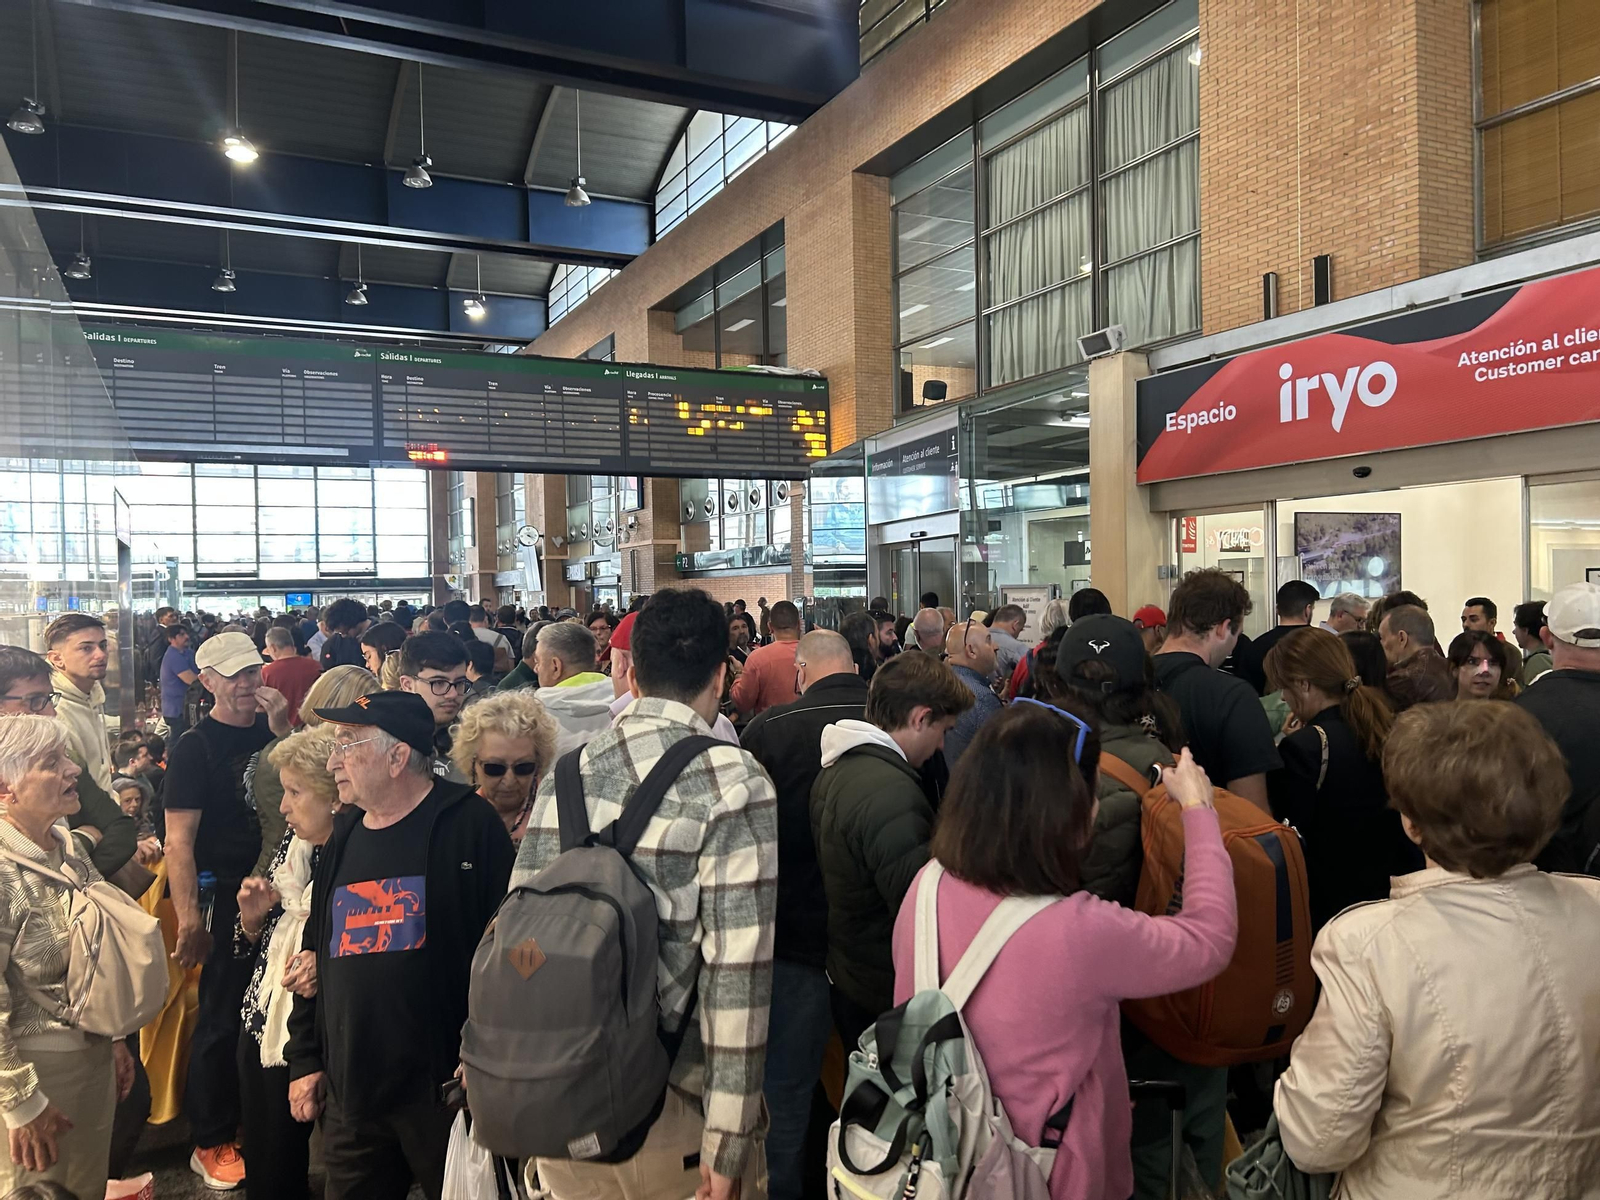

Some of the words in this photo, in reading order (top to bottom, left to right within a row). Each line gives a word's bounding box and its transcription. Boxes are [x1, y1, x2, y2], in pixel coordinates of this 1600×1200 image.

[83, 332, 116, 342] Salidas
[1458, 339, 1537, 368] Atención
[1541, 333, 1560, 351] al
[1564, 327, 1600, 346] clie
[380, 352, 408, 362] Salidas
[303, 369, 339, 377] Observaciones
[626, 370, 654, 379] Llegadas
[1474, 356, 1564, 382] Customer
[1278, 361, 1398, 433] iryo
[1166, 401, 1237, 434] Espacio
[902, 450, 920, 464] Atención
[920, 448, 924, 458] al
[925, 445, 940, 457] cliente
[872, 458, 894, 472] Información
[682, 556, 688, 568] P2
